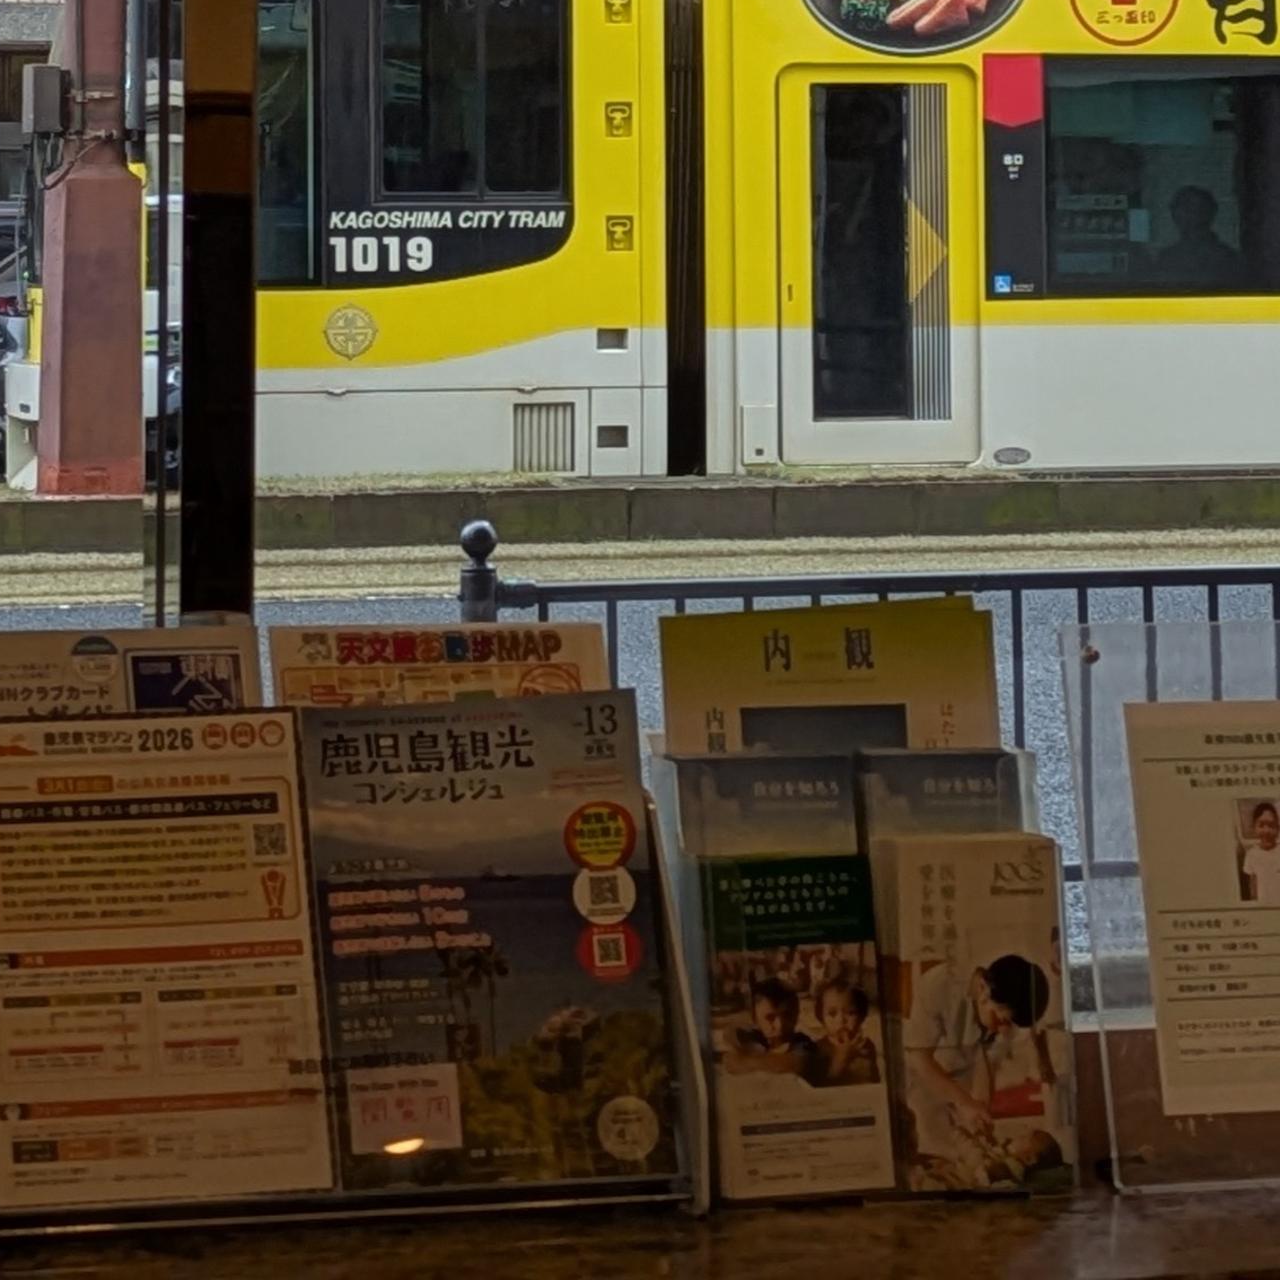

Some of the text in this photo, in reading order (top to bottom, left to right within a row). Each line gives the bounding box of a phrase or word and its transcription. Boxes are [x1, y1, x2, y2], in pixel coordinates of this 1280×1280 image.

[328, 210, 566, 230] KAGOSHIMA CITY TRAM
[328, 235, 434, 273] 1019
[138, 727, 194, 753] 2026
[320, 723, 536, 779] 鹿児島観光
[352, 777, 505, 805] コンシェルジュ
